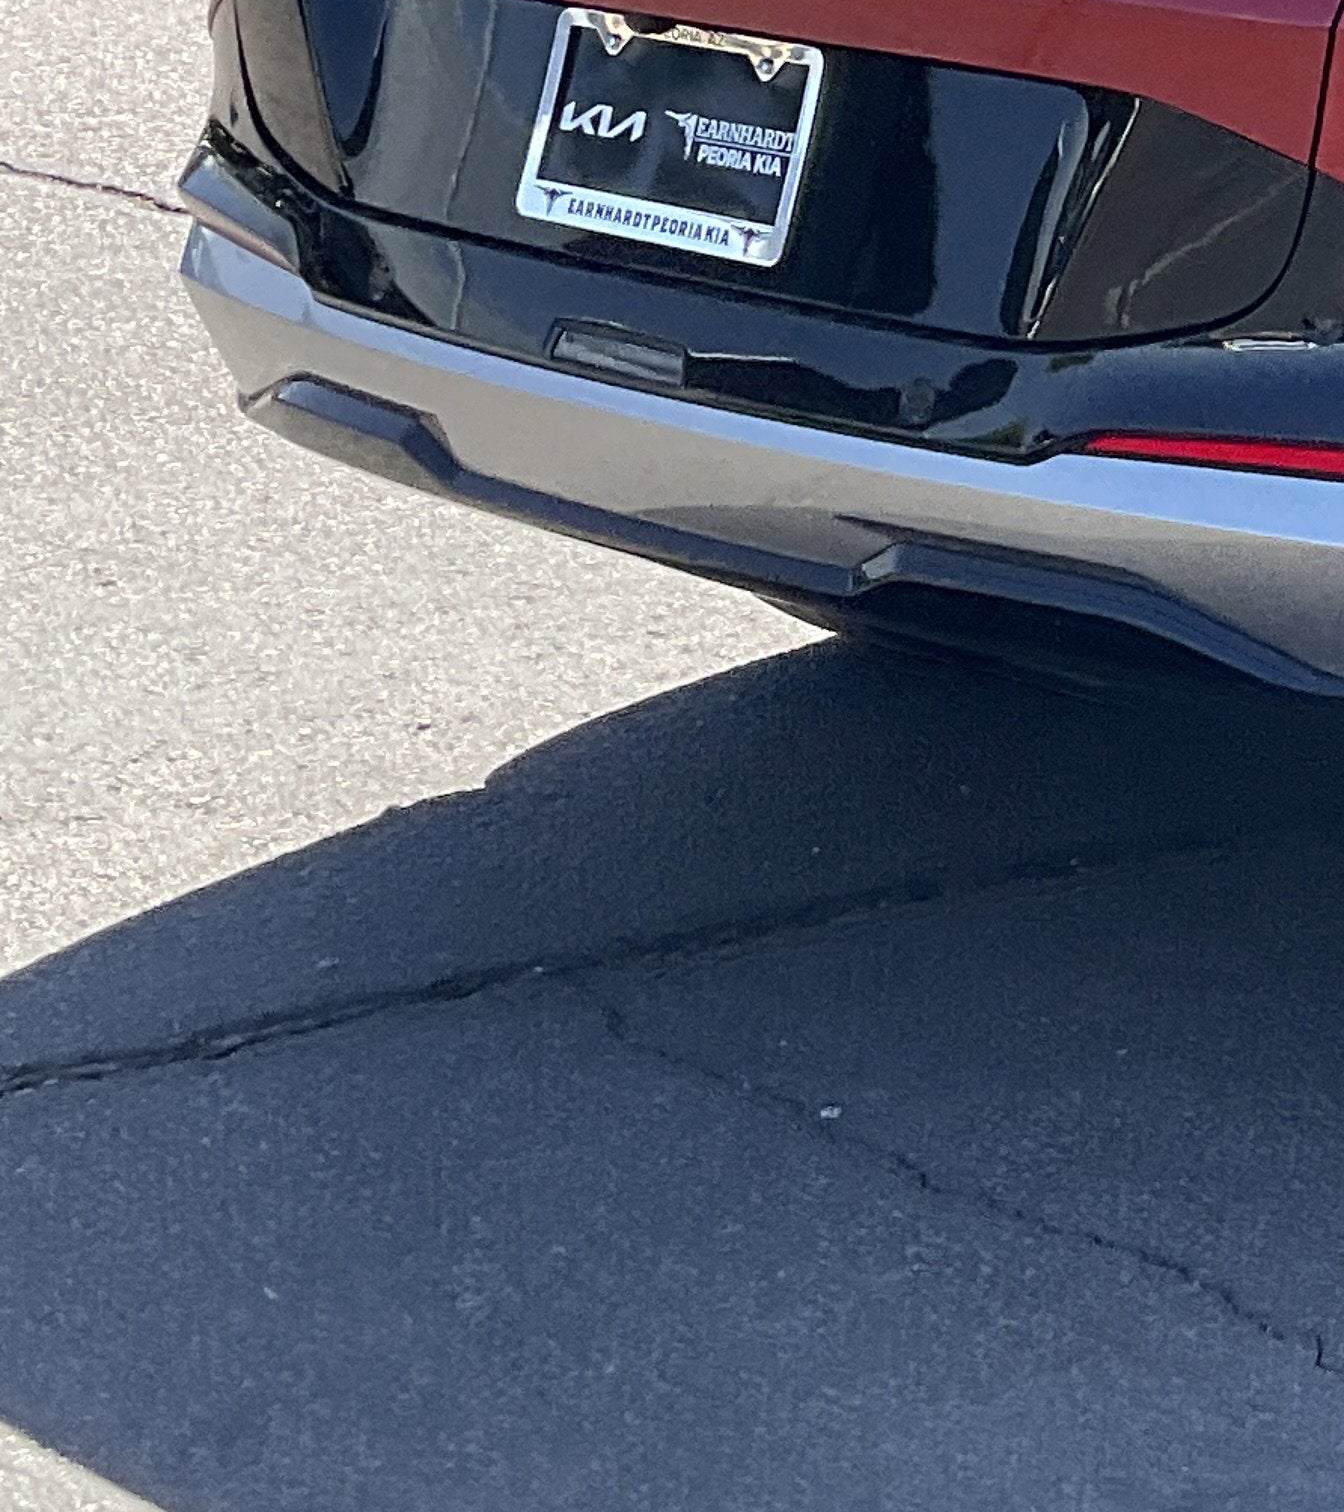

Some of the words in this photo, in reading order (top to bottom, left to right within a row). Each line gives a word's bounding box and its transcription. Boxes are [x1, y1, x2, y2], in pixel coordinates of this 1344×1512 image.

[559, 101, 647, 142] KIA
[696, 117, 795, 151] EARNHARDT
[697, 144, 752, 171] PEORIA
[753, 154, 781, 177] KIA
[705, 225, 730, 246] KIA
